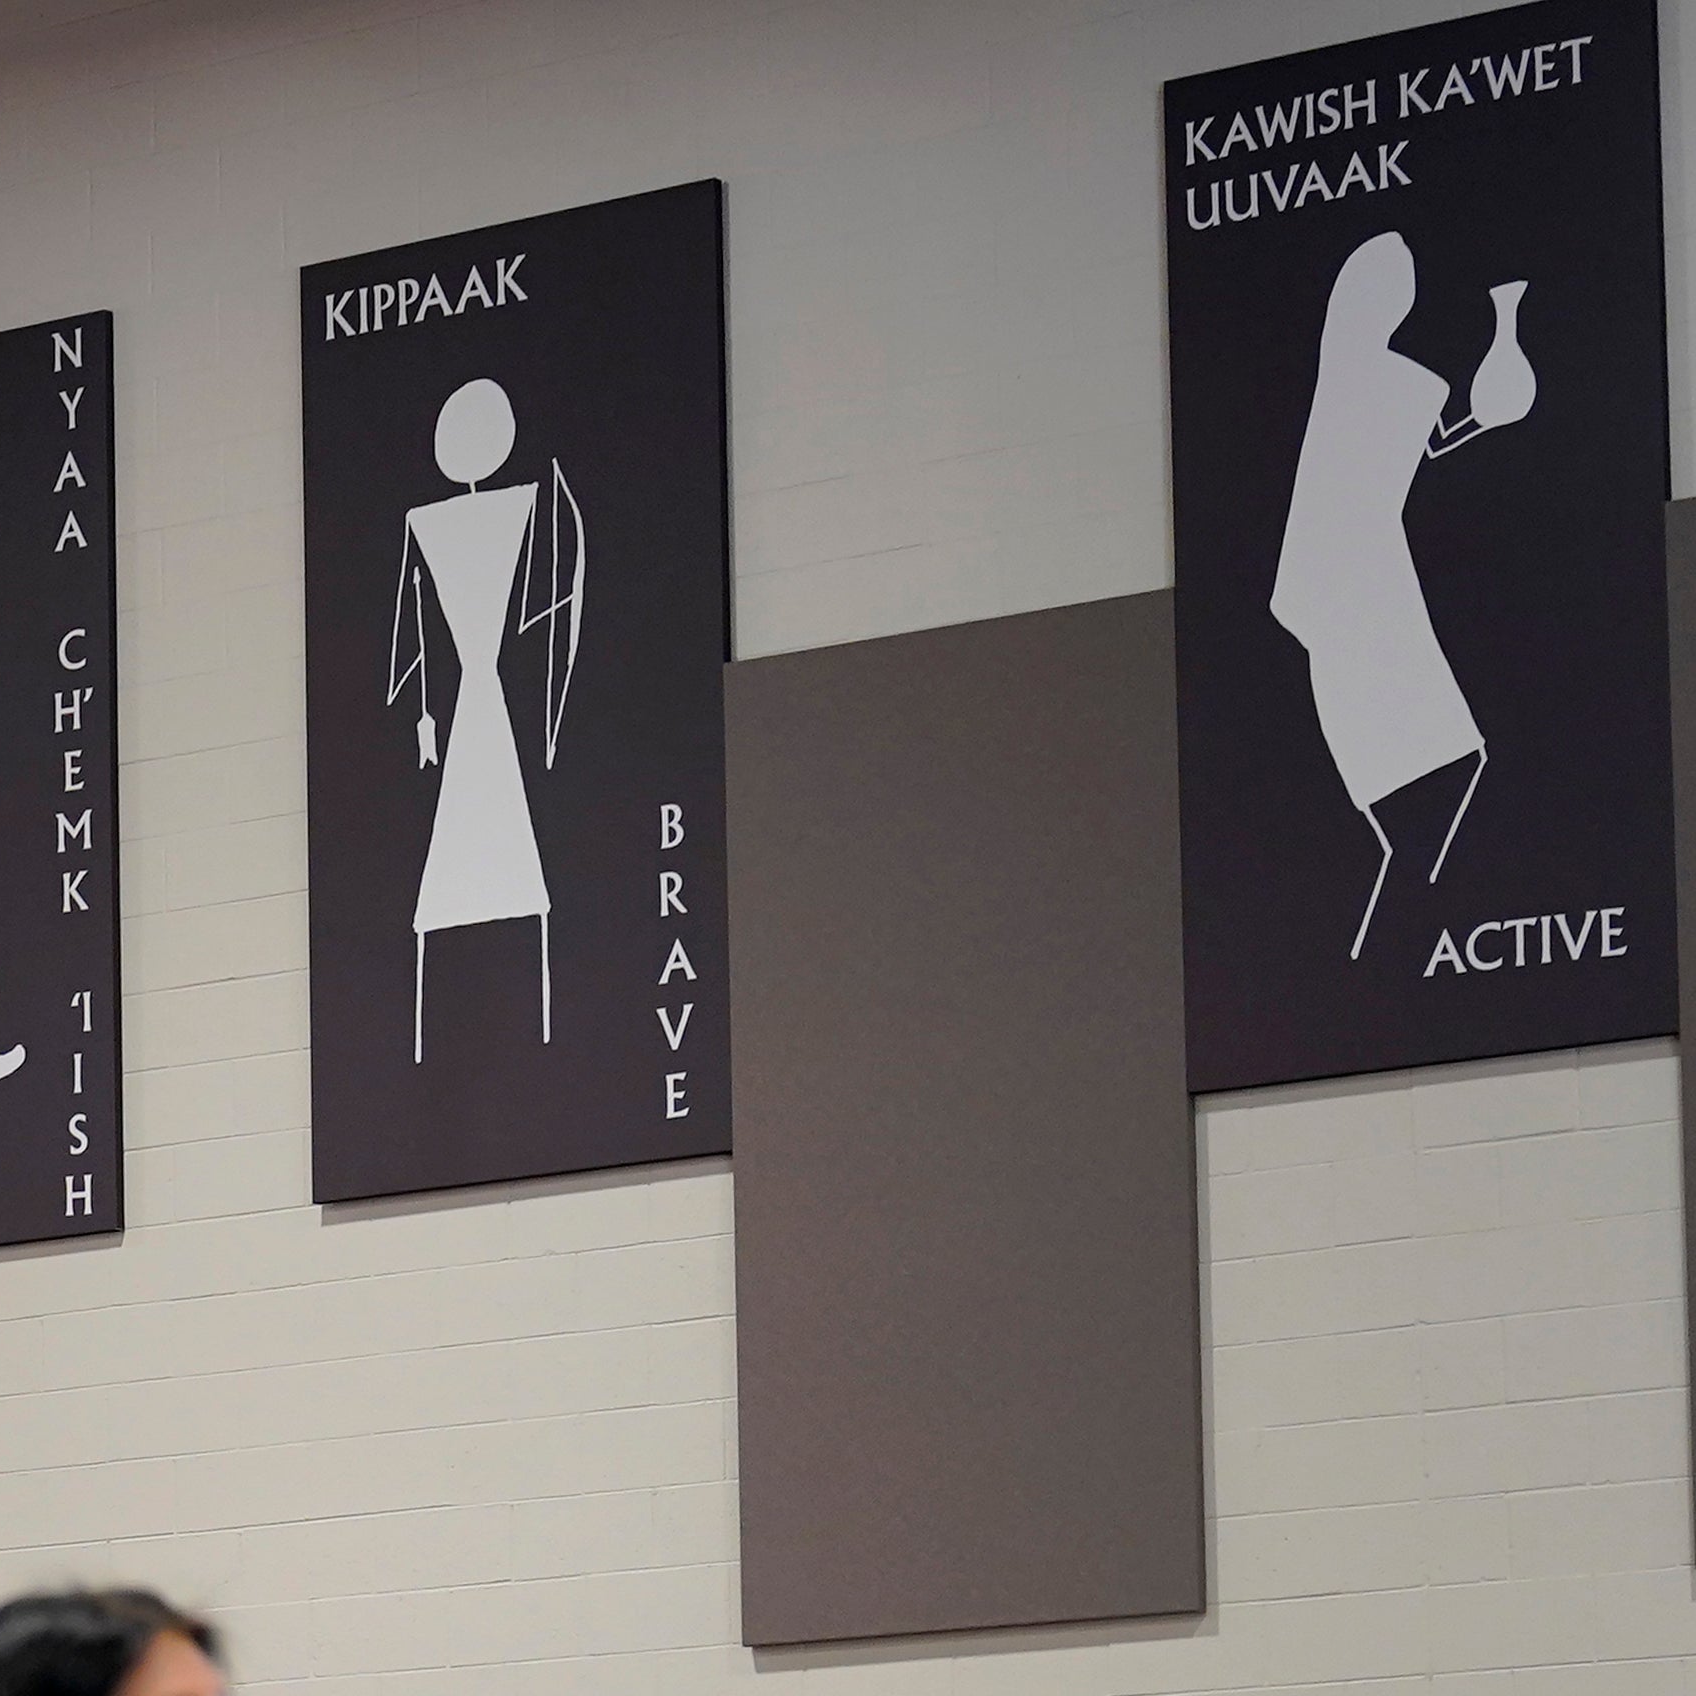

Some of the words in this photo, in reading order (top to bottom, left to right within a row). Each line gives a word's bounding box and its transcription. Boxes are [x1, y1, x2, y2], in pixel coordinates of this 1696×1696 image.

[1184, 78, 1378, 167] KAWISH
[1397, 34, 1594, 119] KA'WET
[1185, 139, 1414, 232] UUVAAK
[324, 252, 529, 342] KIPPAAK
[50, 326, 89, 554] NYAA
[53, 627, 95, 914] CH'EMK
[655, 802, 698, 1120] BRAVE
[1421, 905, 1629, 979] ACTIVE
